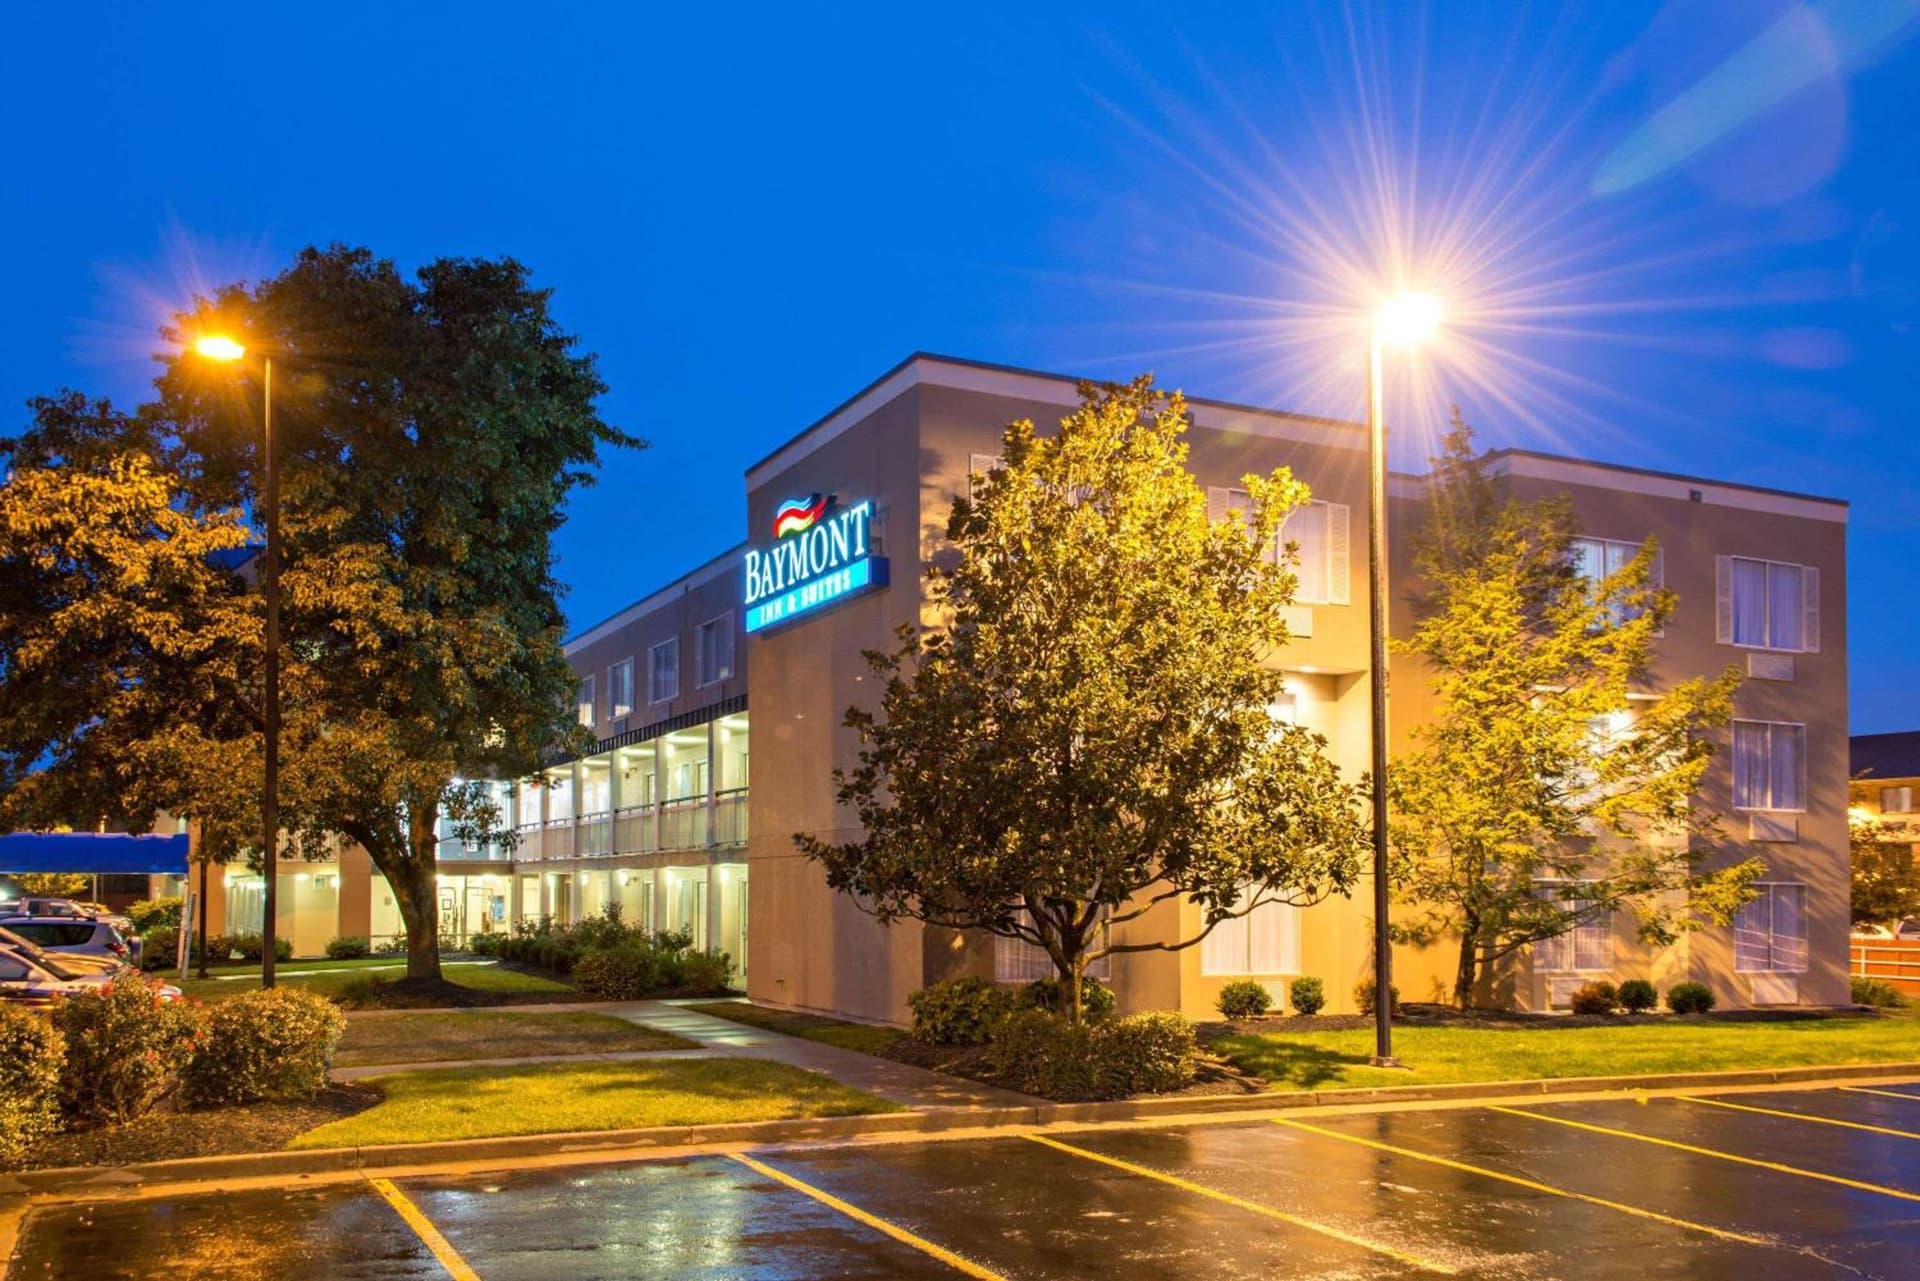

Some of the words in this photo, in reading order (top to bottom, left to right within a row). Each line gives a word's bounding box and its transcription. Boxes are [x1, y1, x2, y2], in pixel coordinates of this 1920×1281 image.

[744, 501, 869, 604] BAYMONT
[760, 601, 782, 625] INN
[801, 569, 851, 607] SUITES
